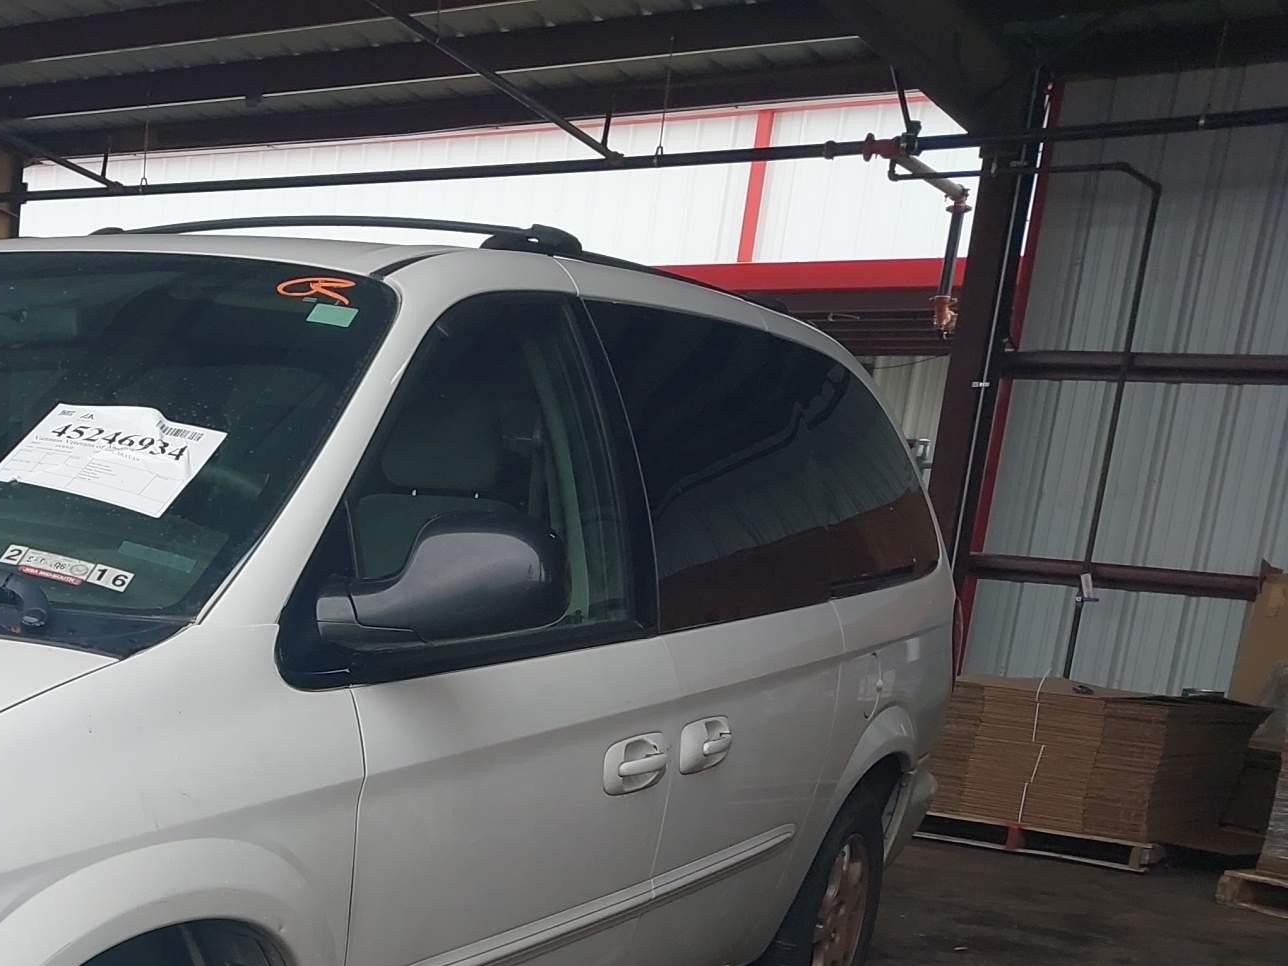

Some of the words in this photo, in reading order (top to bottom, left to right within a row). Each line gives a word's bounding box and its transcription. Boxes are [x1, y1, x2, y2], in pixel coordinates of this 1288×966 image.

[51, 423, 189, 461] 45246934
[5, 548, 22, 561] 2
[96, 568, 130, 588] 16
